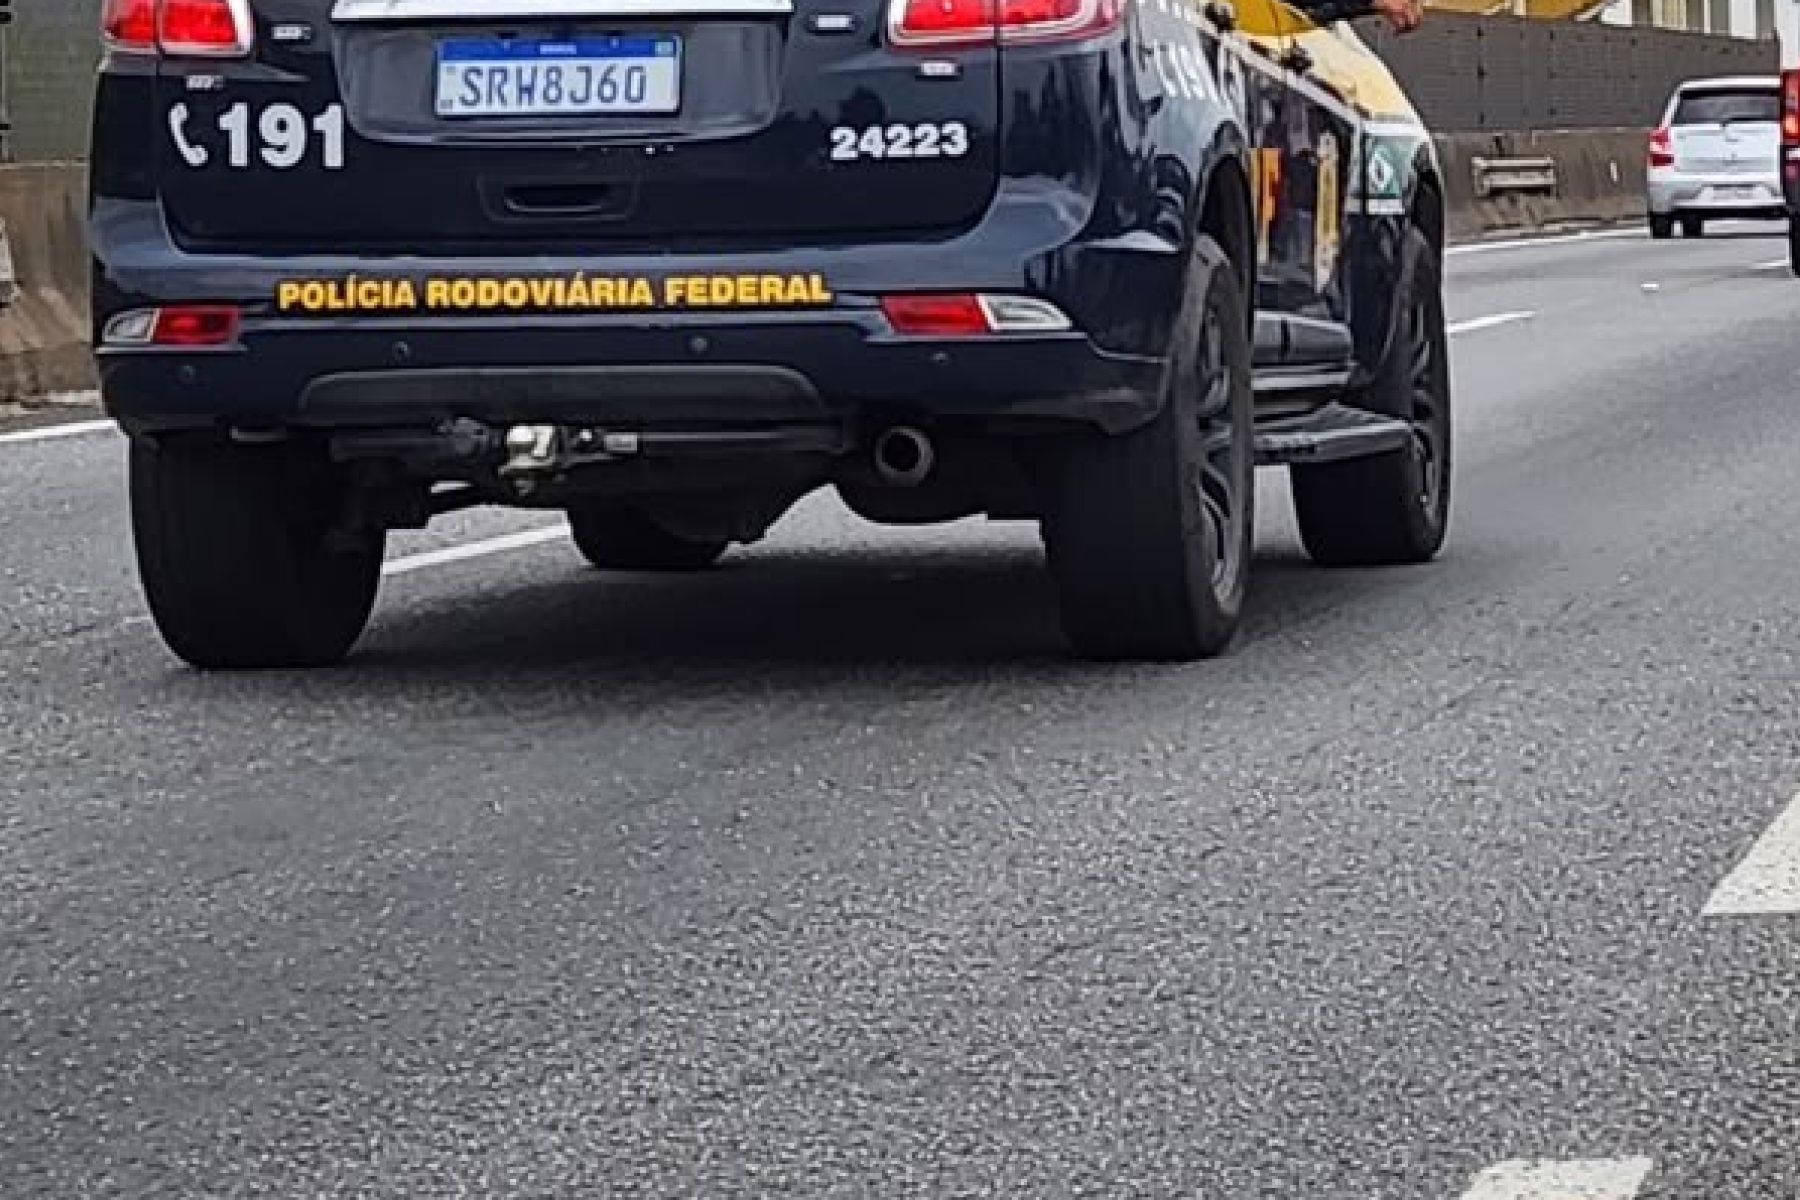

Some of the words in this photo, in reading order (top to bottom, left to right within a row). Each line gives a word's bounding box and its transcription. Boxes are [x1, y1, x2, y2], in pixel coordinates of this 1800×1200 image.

[216, 101, 345, 170] 191
[829, 122, 970, 163] 24223
[278, 274, 416, 310] POLÍCIA
[426, 271, 655, 309] RODOVIÁRIA
[662, 274, 833, 306] FEDERAL
